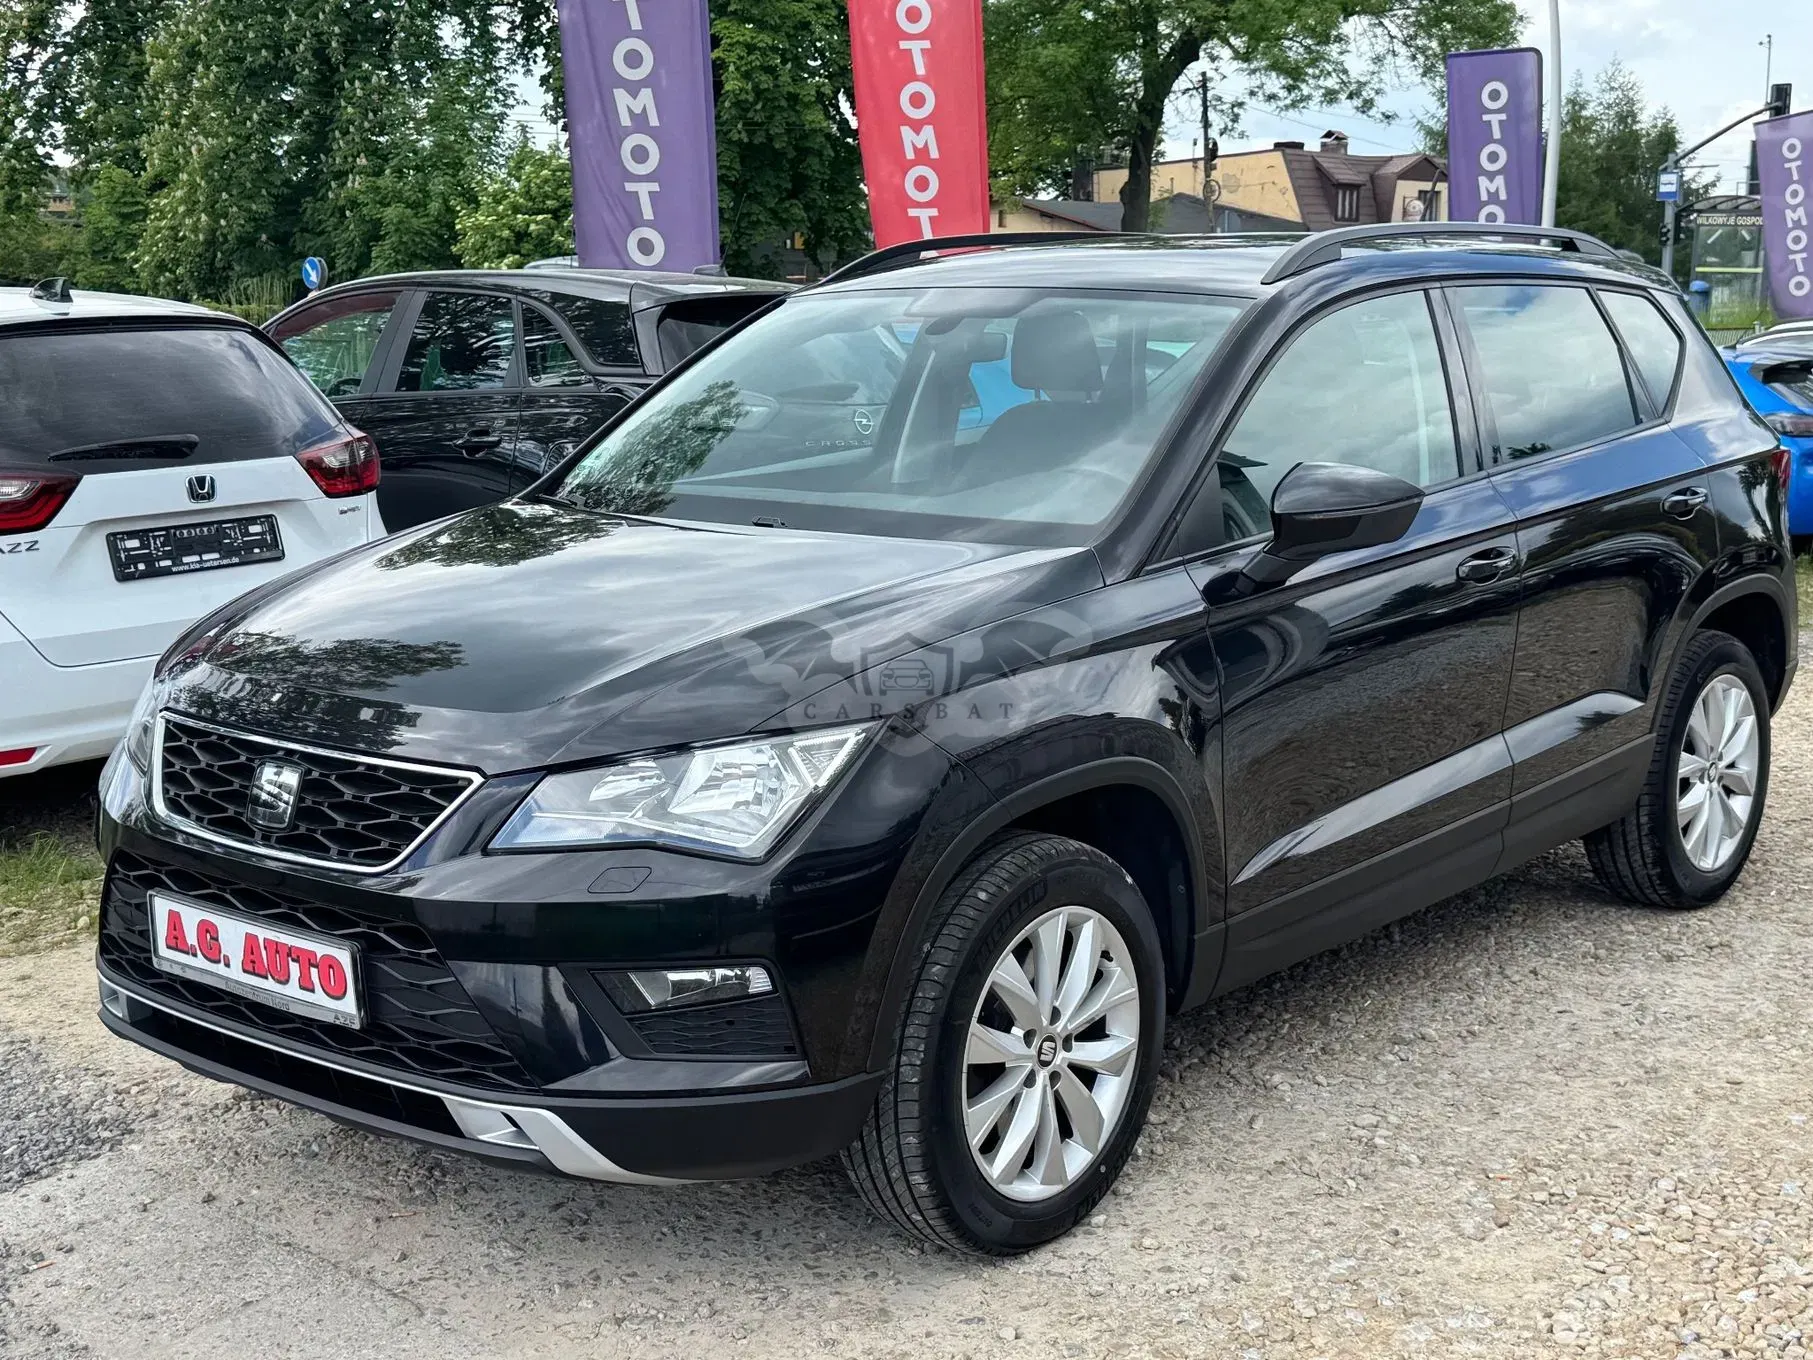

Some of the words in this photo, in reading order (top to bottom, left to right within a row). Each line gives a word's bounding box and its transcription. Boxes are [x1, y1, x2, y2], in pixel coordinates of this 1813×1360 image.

[612, 0, 665, 267] TOMOTO
[895, 0, 939, 259] OTOMOT
[1478, 81, 1508, 241] OTOMO
[1697, 216, 1735, 225] WILKOWYJE
[1781, 137, 1811, 297] OTOMOTO
[165, 908, 230, 968] A.G.
[241, 932, 347, 1000] AUTO
